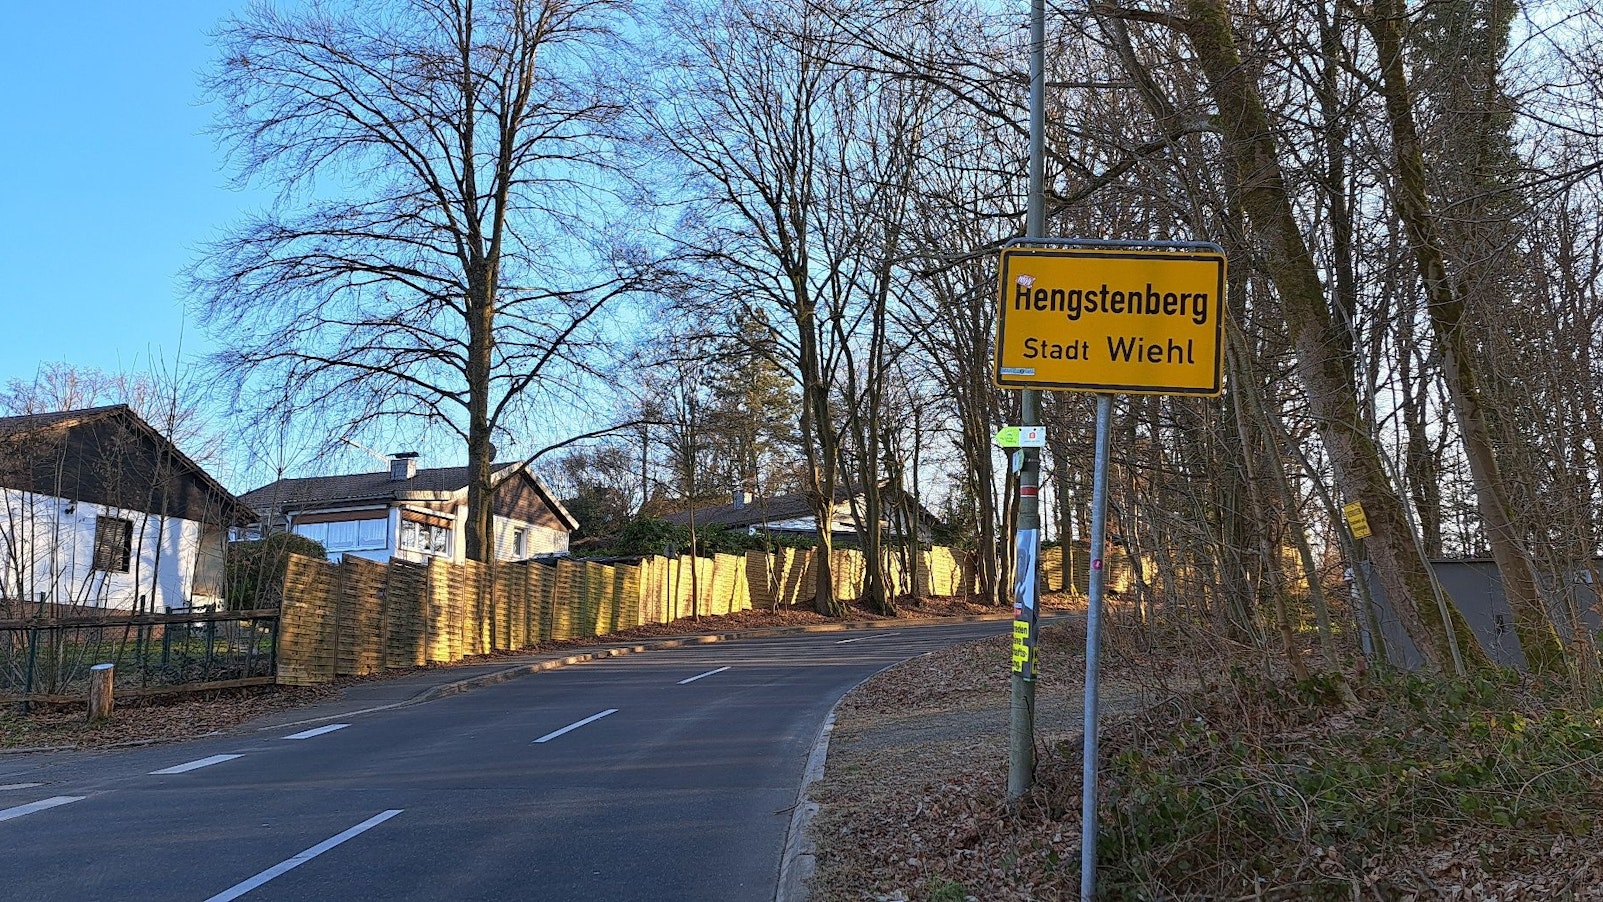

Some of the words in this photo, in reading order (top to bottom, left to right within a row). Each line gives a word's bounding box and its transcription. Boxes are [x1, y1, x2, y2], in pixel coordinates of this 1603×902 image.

[1015, 282, 1208, 325] Hengstenberg
[1023, 337, 1090, 361] Stadt
[1106, 336, 1195, 365] Wiehl
